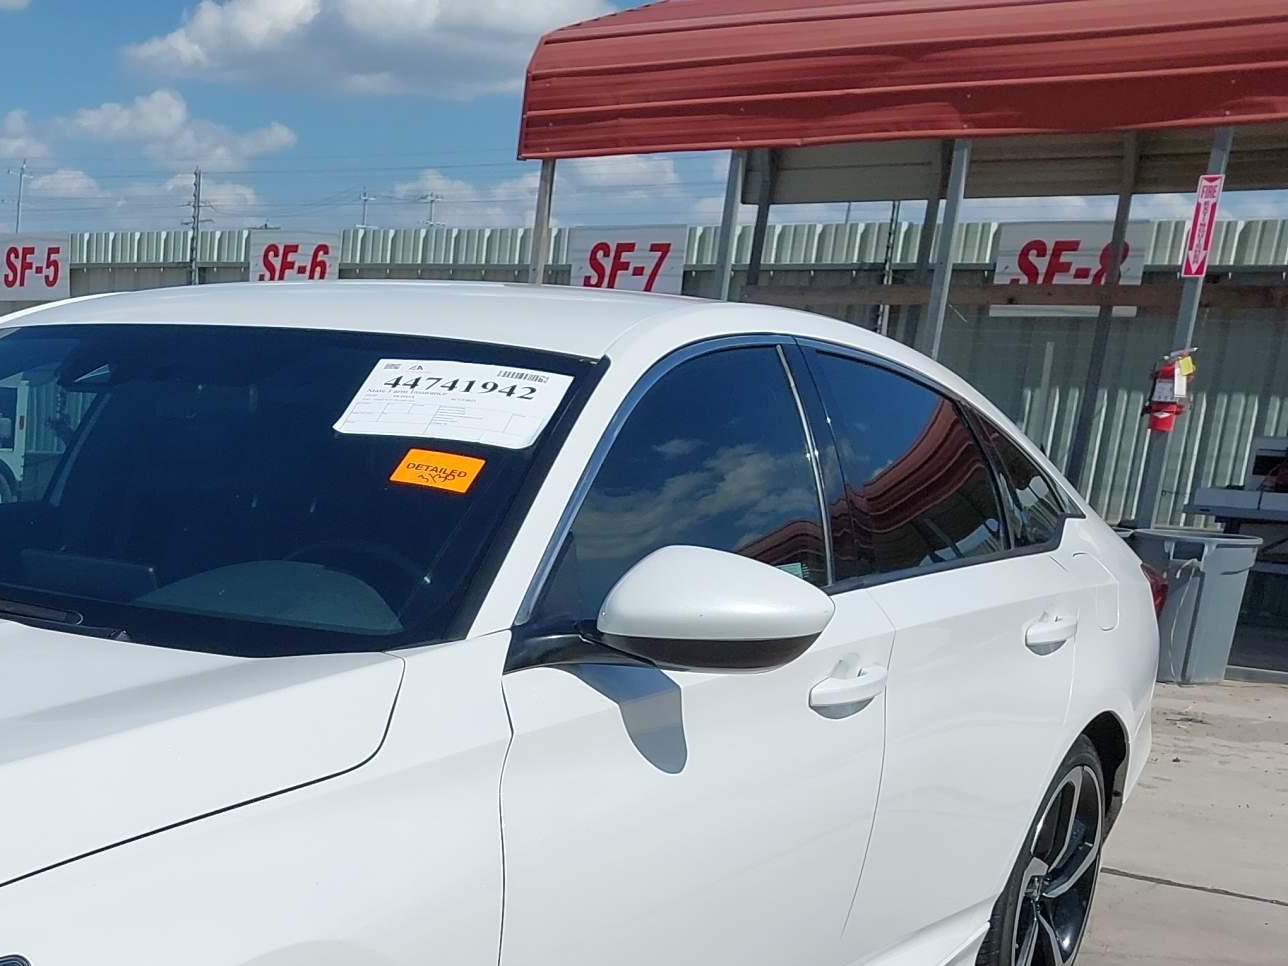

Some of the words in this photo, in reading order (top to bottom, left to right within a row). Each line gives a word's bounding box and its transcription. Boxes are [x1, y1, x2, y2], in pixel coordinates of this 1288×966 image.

[4, 246, 60, 288] SF-5
[258, 244, 329, 281] SF-6
[584, 242, 671, 292] SF-7
[383, 376, 537, 400] 44741942
[406, 463, 467, 478] DETAILED
